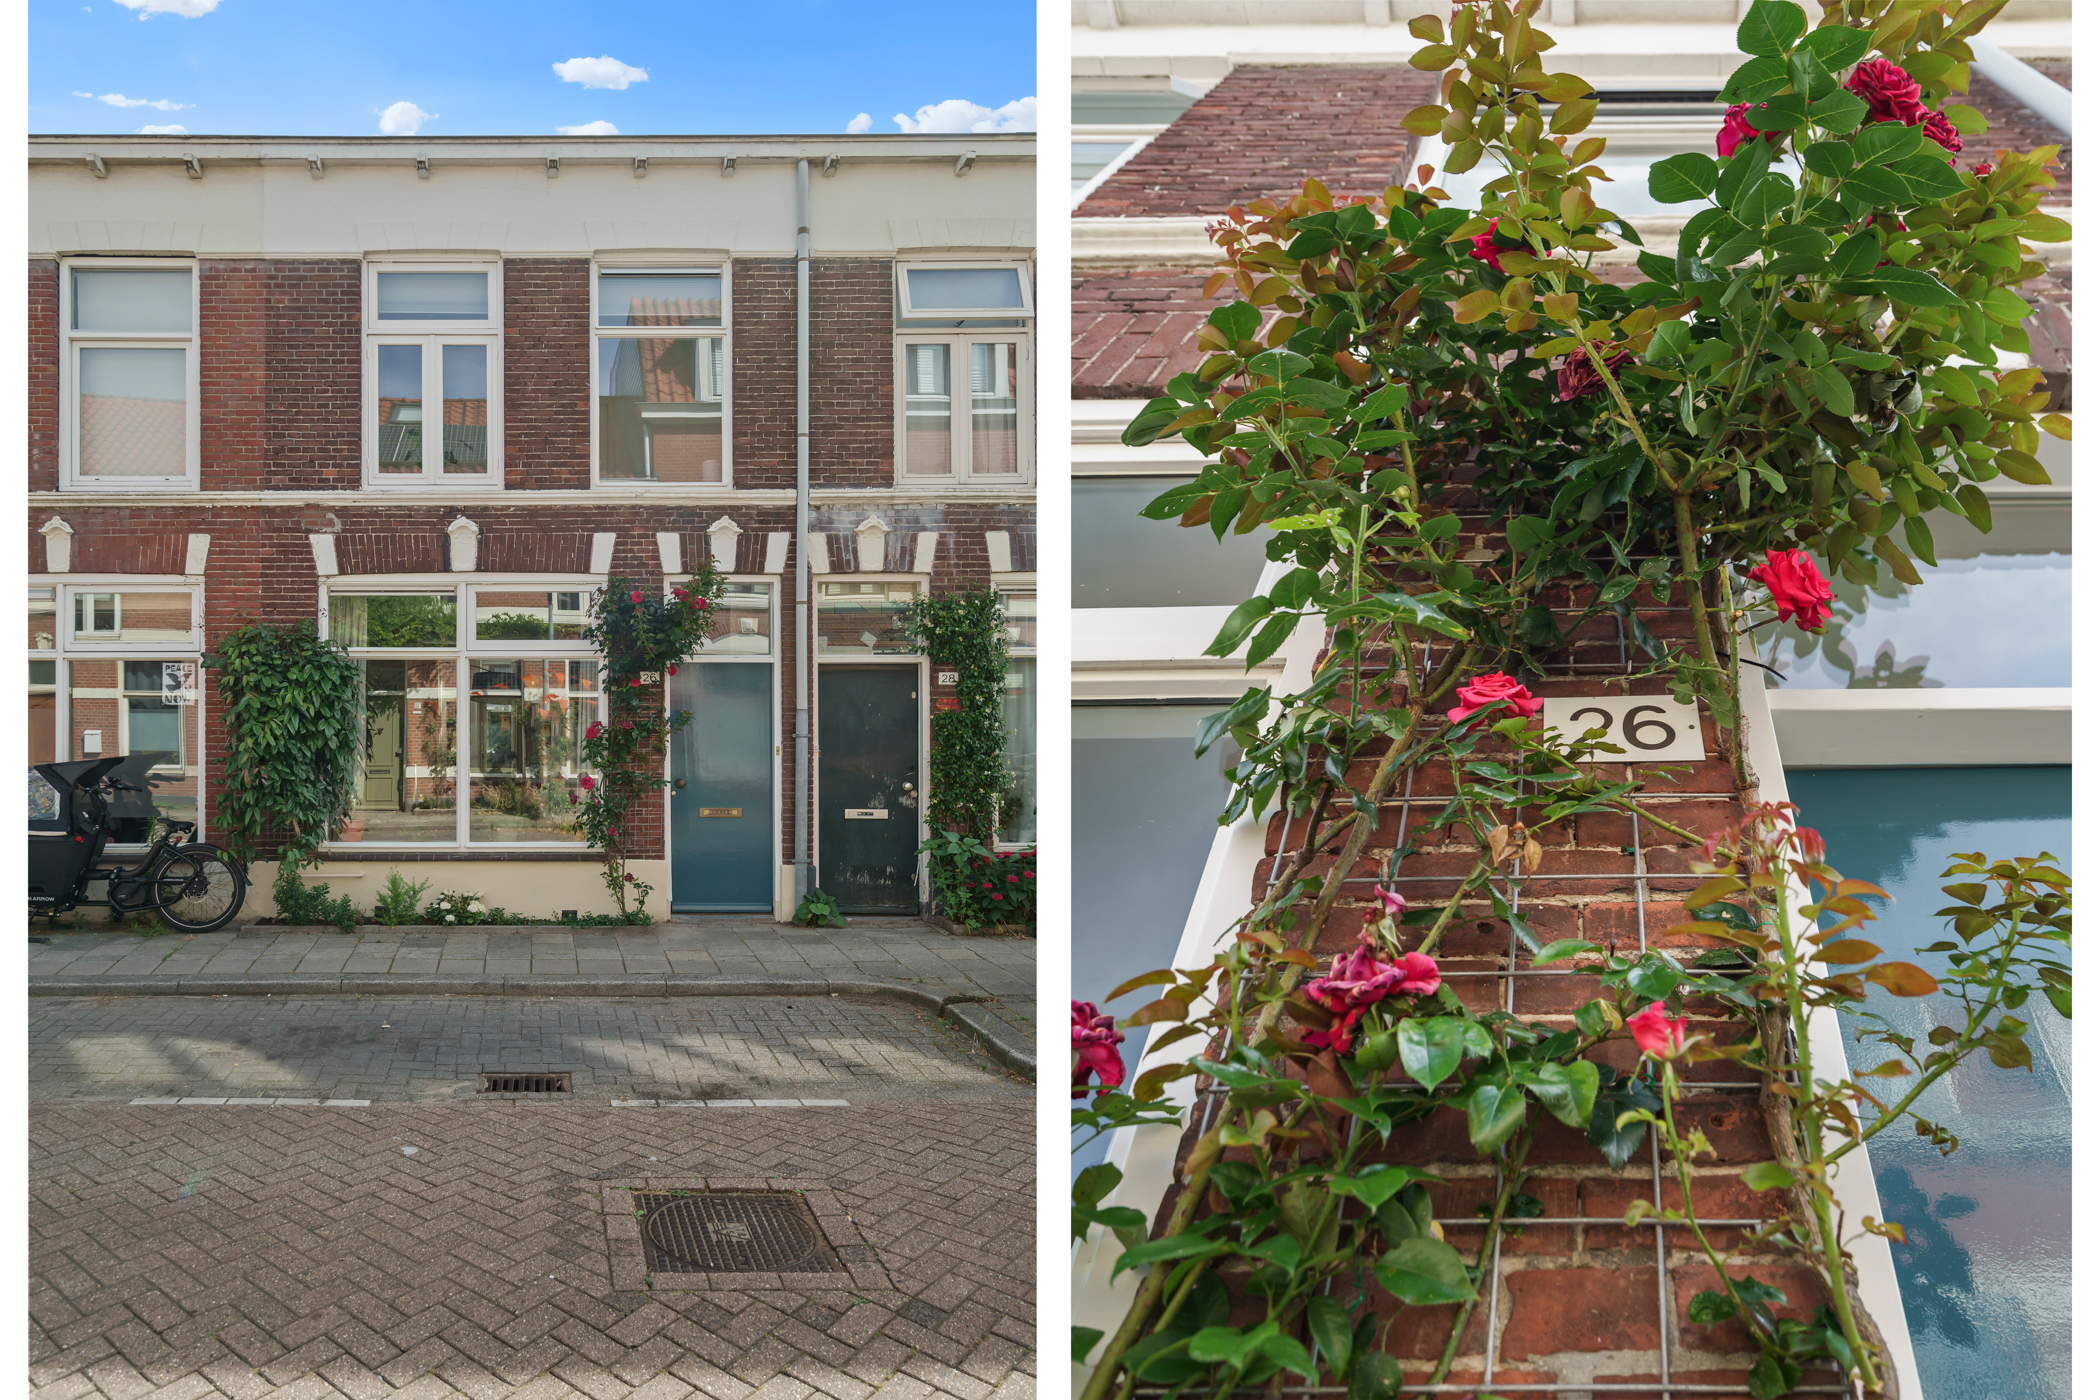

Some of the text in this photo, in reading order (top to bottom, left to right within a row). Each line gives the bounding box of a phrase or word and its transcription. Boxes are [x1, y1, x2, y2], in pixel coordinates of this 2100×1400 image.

[165, 664, 193, 673] PEACE
[642, 672, 656, 682] 26
[941, 673, 956, 683] 28
[164, 694, 193, 704] NOW
[1569, 704, 1677, 751] 26
